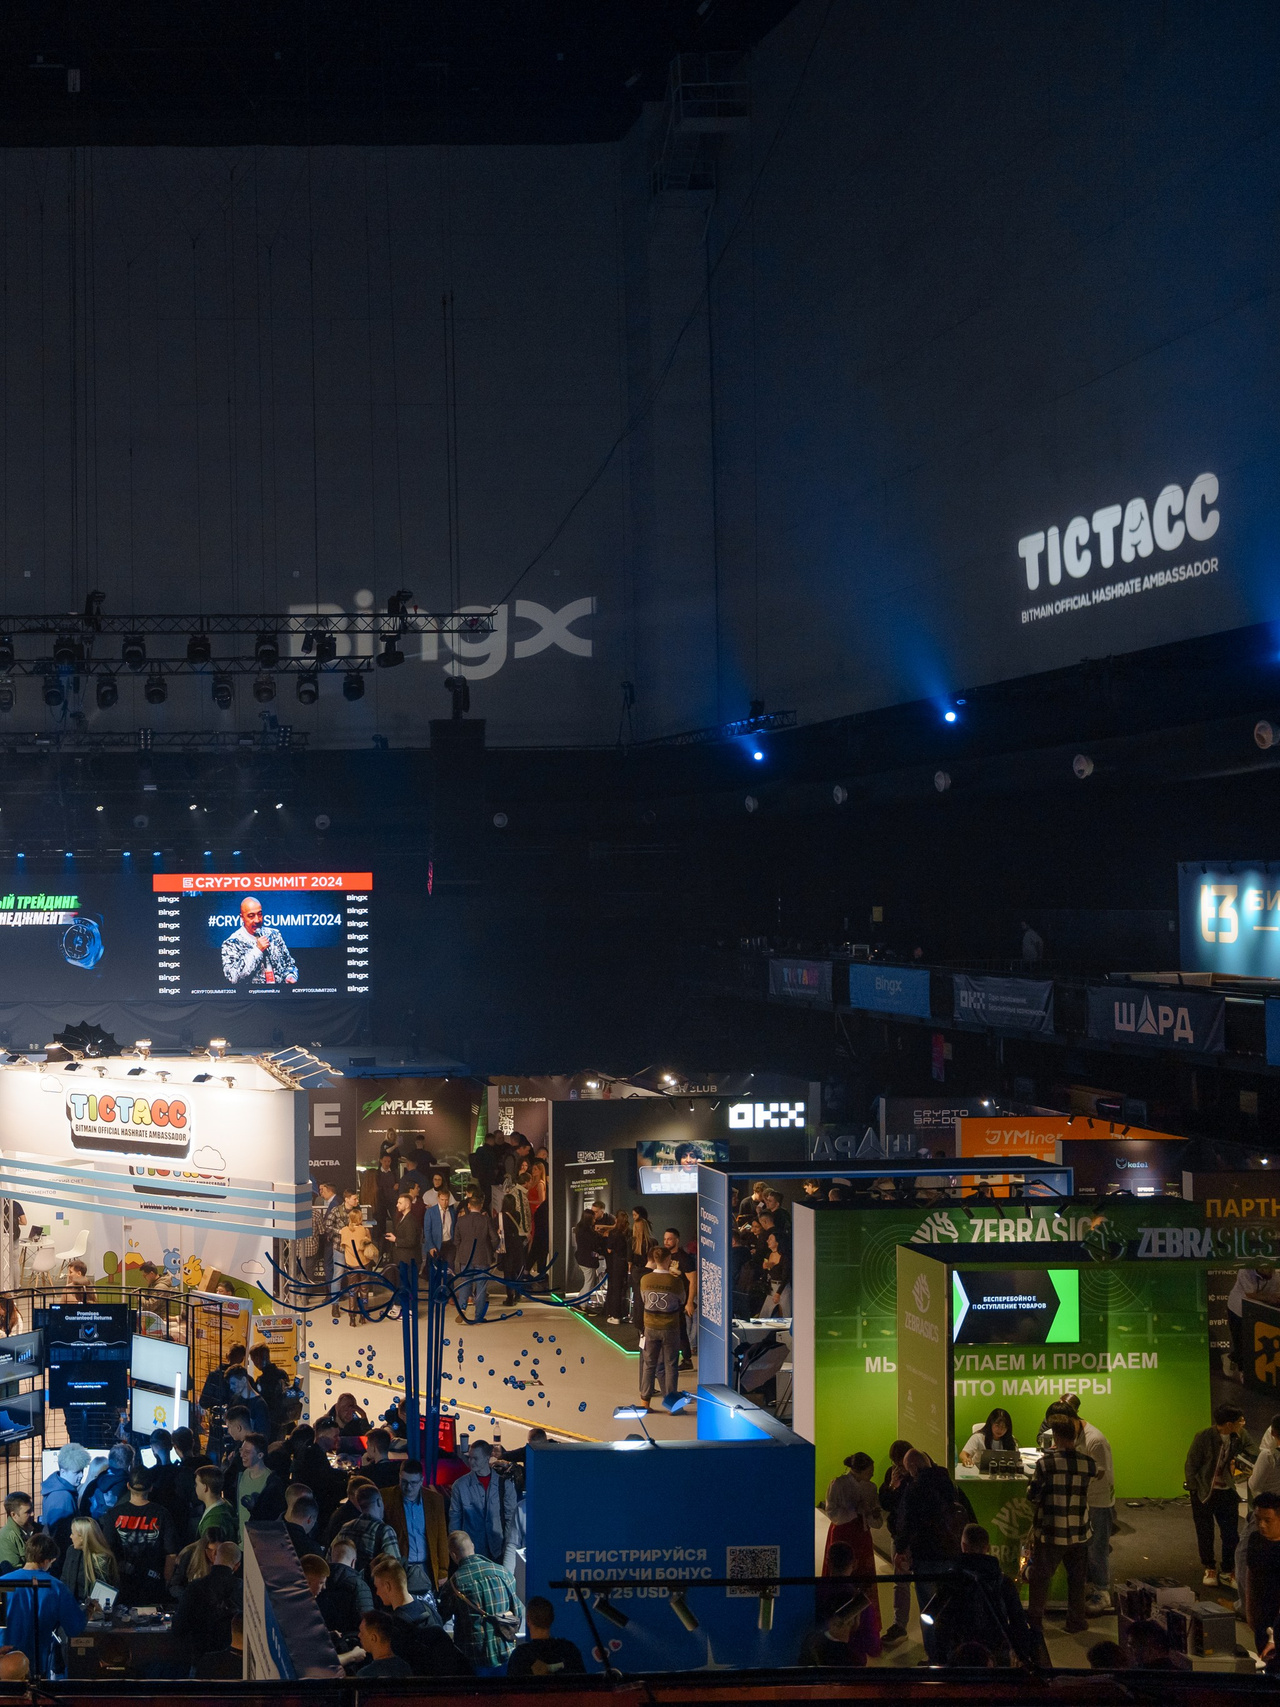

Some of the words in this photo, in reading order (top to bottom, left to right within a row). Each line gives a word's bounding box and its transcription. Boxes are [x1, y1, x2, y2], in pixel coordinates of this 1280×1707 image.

[1018, 472, 1220, 591] TICTACC
[1021, 603, 1054, 624] BITMAIN
[1054, 592, 1091, 615] OFFICIAL
[1092, 577, 1141, 604] HASHRATE
[1142, 558, 1219, 591] AMBASSADOR
[195, 876, 251, 888] CRYPTO
[254, 876, 307, 888] SUMMIT
[311, 876, 343, 887] 2024
[17, 894, 80, 911] ТРЕЙДИНГ
[208, 914, 342, 927] #CRYSUMMIT2024
[501, 1085, 520, 1095] NEX
[70, 1094, 188, 1128] TICTACC
[381, 1100, 434, 1111] IMPULSE
[313, 1102, 342, 1136] E
[729, 1102, 804, 1128] OKX
[76, 1124, 97, 1133] BITMAIN
[98, 1126, 120, 1135] OFFICIAL
[120, 1128, 148, 1138] HASHRATE
[148, 1130, 187, 1141] AMBASSADOR
[700, 1206, 719, 1226] Проверь
[701, 1237, 716, 1252] крипту
[647, 1292, 669, 1310] 93
[972, 1302, 1016, 1310] ПОСТУПЛЕНИЕ
[1018, 1302, 1047, 1310] ТОВАРОВ
[954, 1354, 1025, 1372] УПАЕМ
[1033, 1353, 1046, 1370] И
[1052, 1353, 1158, 1372] ПРОДАЕМ
[954, 1380, 994, 1396] ПТО
[1002, 1374, 1112, 1396] МАЙНЕРЫ
[566, 1546, 707, 1563] РЕГИСТРИРУЙСЯ
[582, 1568, 653, 1580] ПОЛУЧИ
[656, 1567, 712, 1580] БОНУС
